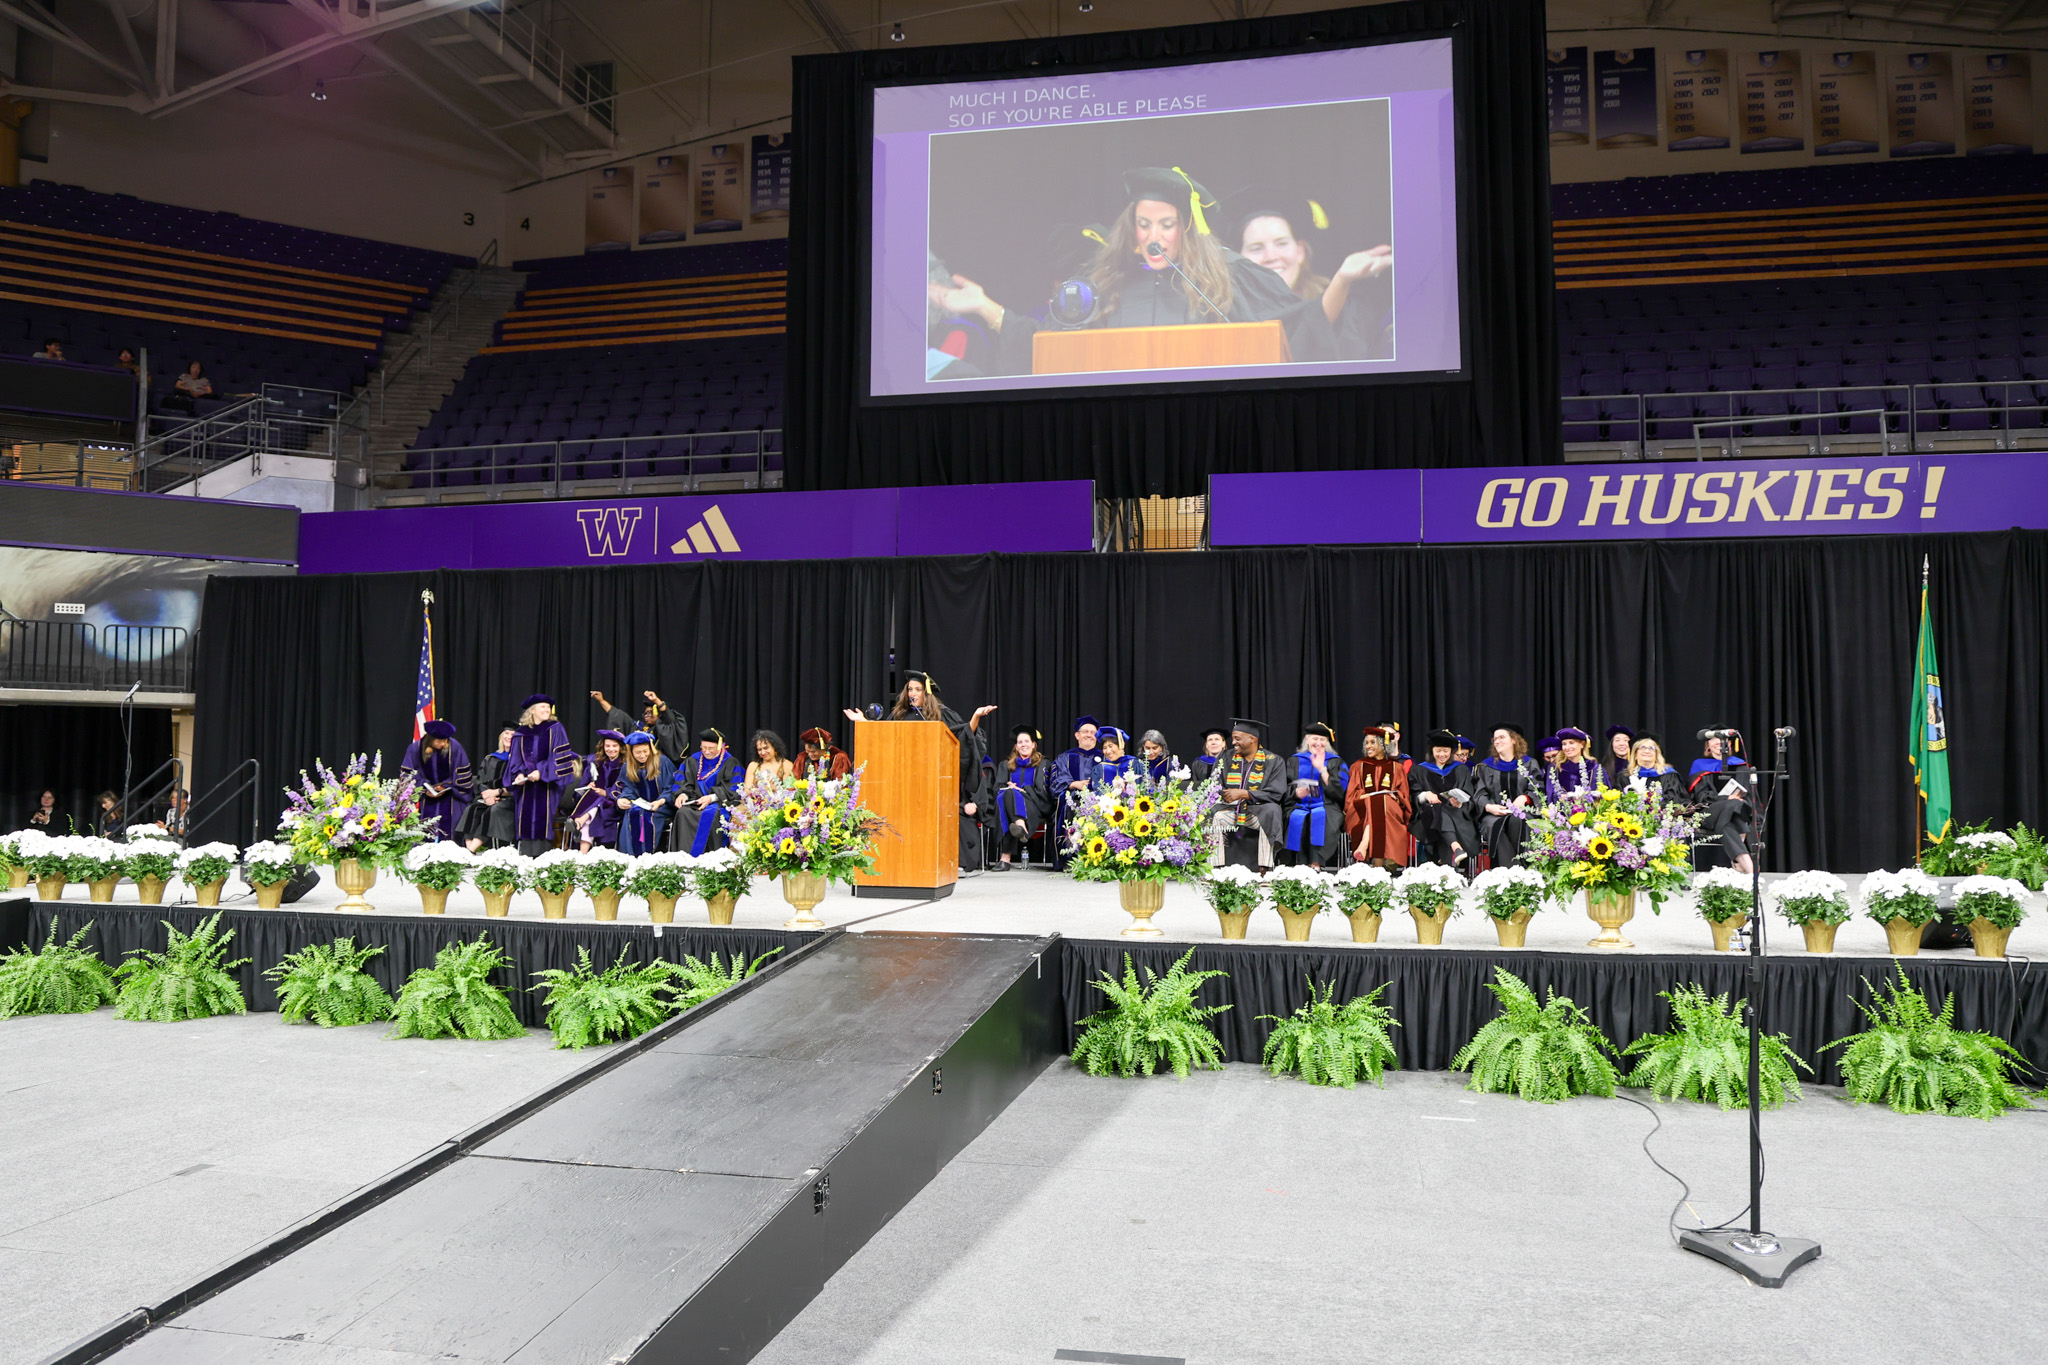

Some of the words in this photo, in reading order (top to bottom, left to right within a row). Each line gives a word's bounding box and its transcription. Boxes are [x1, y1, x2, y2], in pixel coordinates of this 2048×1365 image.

[1563, 74, 1580, 82] 1994
[1674, 78, 1693, 87] 2004
[1702, 76, 1721, 84] 2020
[1775, 78, 1793, 86] 2007
[1564, 85, 1580, 93] 1997
[1820, 81, 1837, 90] 1997
[949, 92, 1006, 109] MUCH
[1013, 90, 1017, 104] I
[1025, 84, 1096, 103] DANCE.
[1674, 90, 1693, 98] 2005
[1702, 88, 1719, 96] 2021
[1820, 93, 1838, 102] 2012
[1674, 102, 1693, 110] 2013
[1748, 102, 1765, 111] 1994
[1778, 101, 1794, 109] 2011
[1820, 105, 1840, 113] 2014
[948, 113, 975, 128] SO
[982, 111, 997, 125] IF
[1003, 105, 1073, 124] YOU'RE
[1080, 101, 1128, 118] ABLE
[1136, 94, 1207, 114] PLEASE
[1674, 112, 1695, 121] 2015
[1778, 112, 1794, 121] 2017
[464, 213, 474, 226] 3
[520, 218, 530, 230] 4
[1476, 477, 1569, 529] GO
[576, 507, 642, 556] W
